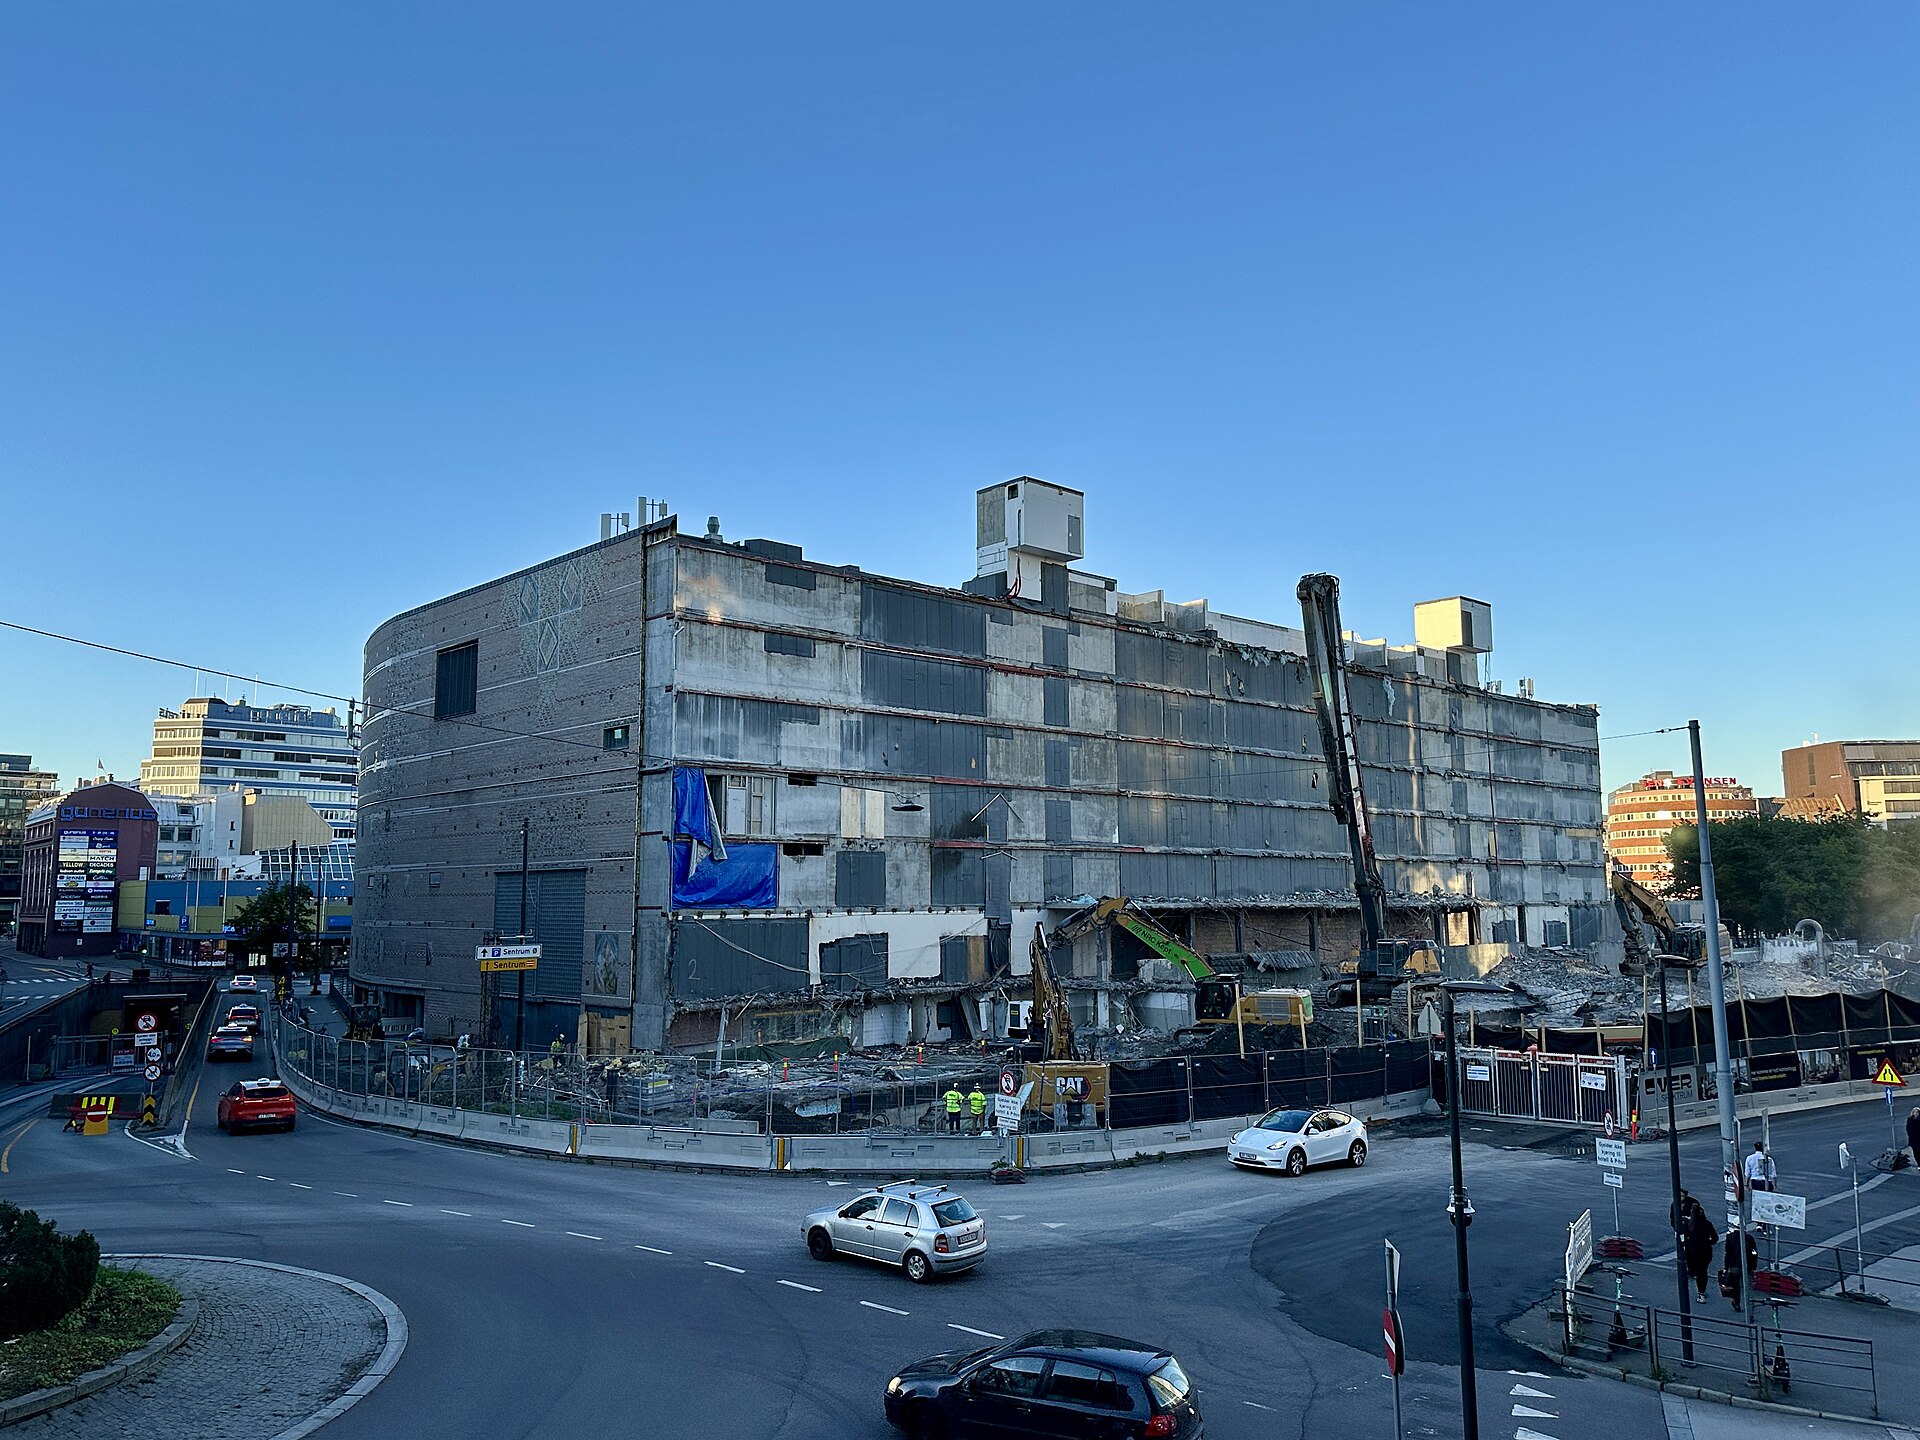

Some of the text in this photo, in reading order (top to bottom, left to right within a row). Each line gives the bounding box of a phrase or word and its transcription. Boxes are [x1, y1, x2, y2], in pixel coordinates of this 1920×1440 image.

[1677, 777, 1736, 785] EVNSEN
[1141, 931, 1172, 954] NRC Kept
[494, 961, 525, 969] Sentrum
[688, 958, 700, 980] 2
[1056, 1077, 1083, 1095] CAT
